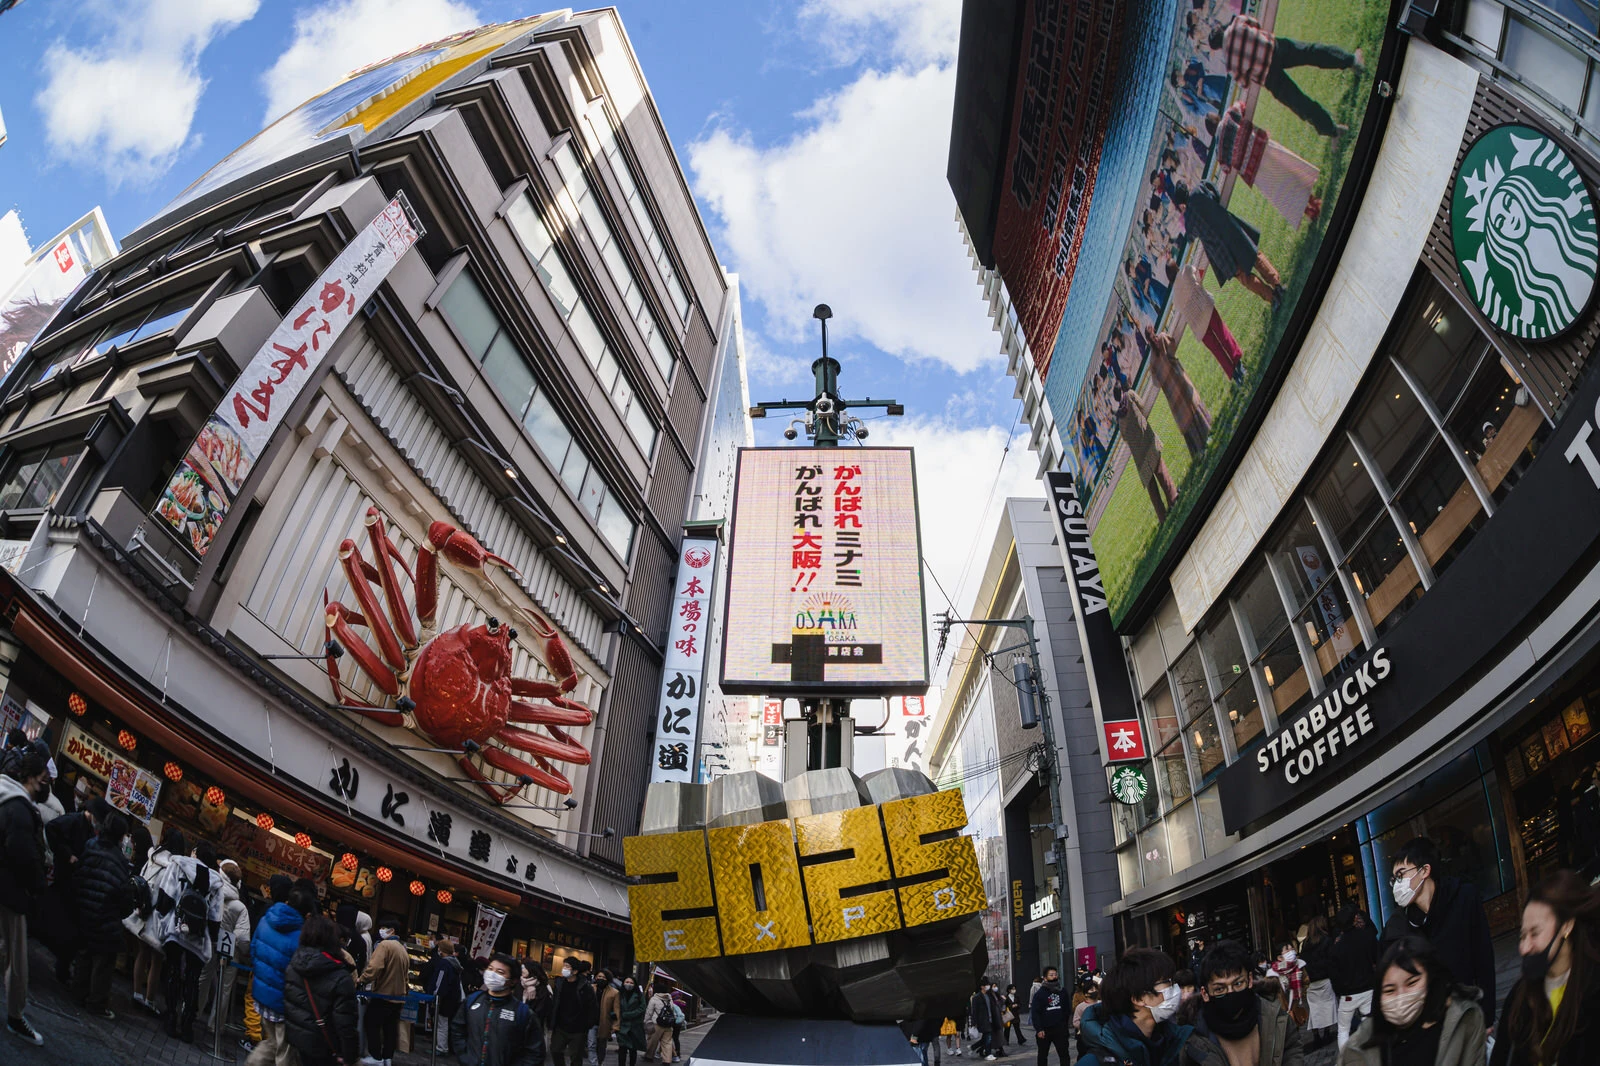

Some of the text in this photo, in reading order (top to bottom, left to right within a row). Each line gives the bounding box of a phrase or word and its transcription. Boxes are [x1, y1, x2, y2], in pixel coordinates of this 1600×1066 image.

[1055, 164, 1087, 280] 中山競馬場
[233, 279, 356, 429] かにすき
[833, 464, 863, 588] がんばれミナミ
[1054, 481, 1109, 616] TSUTAYA
[673, 575, 705, 658] 本場の味
[796, 601, 858, 630] OSAKA
[657, 671, 696, 784] かに道
[903, 714, 932, 772] がん
[1110, 728, 1137, 753] 本
[1256, 647, 1392, 773] STARBUCKS
[1284, 703, 1375, 785] COFFEE
[329, 757, 492, 863] かに道楽
[623, 787, 989, 962] 2025
[221, 931, 232, 954] 入口
